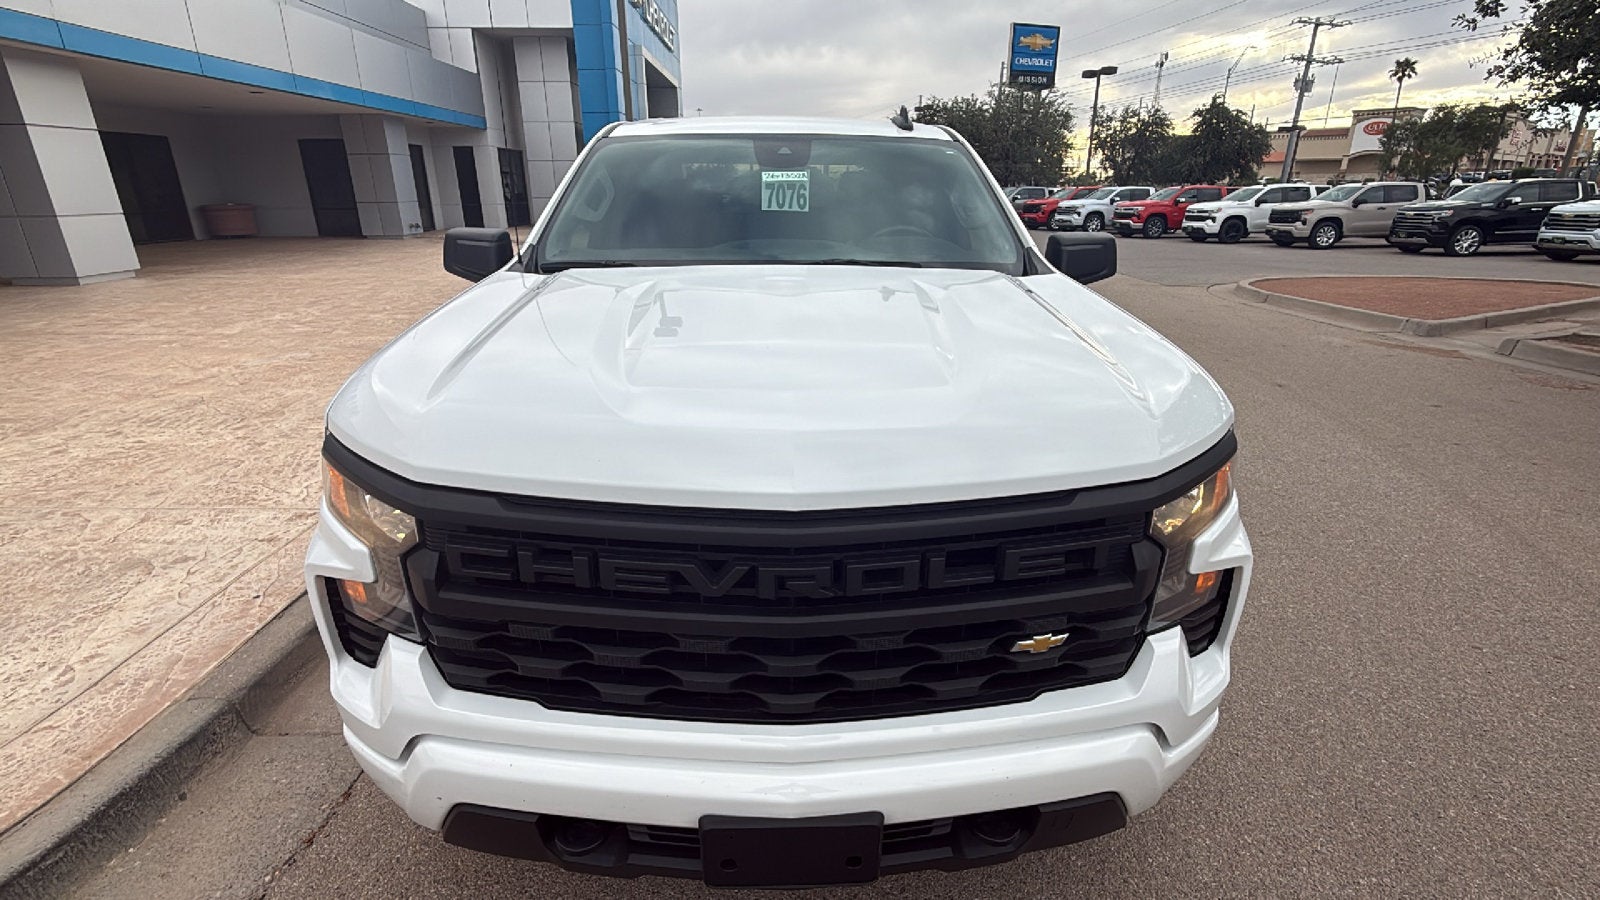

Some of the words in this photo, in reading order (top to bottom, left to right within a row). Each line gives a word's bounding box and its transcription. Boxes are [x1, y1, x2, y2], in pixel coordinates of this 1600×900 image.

[1015, 56, 1054, 67] CHEVROLET
[765, 183, 808, 210] 7076
[445, 536, 1133, 600] CHEVROLET
